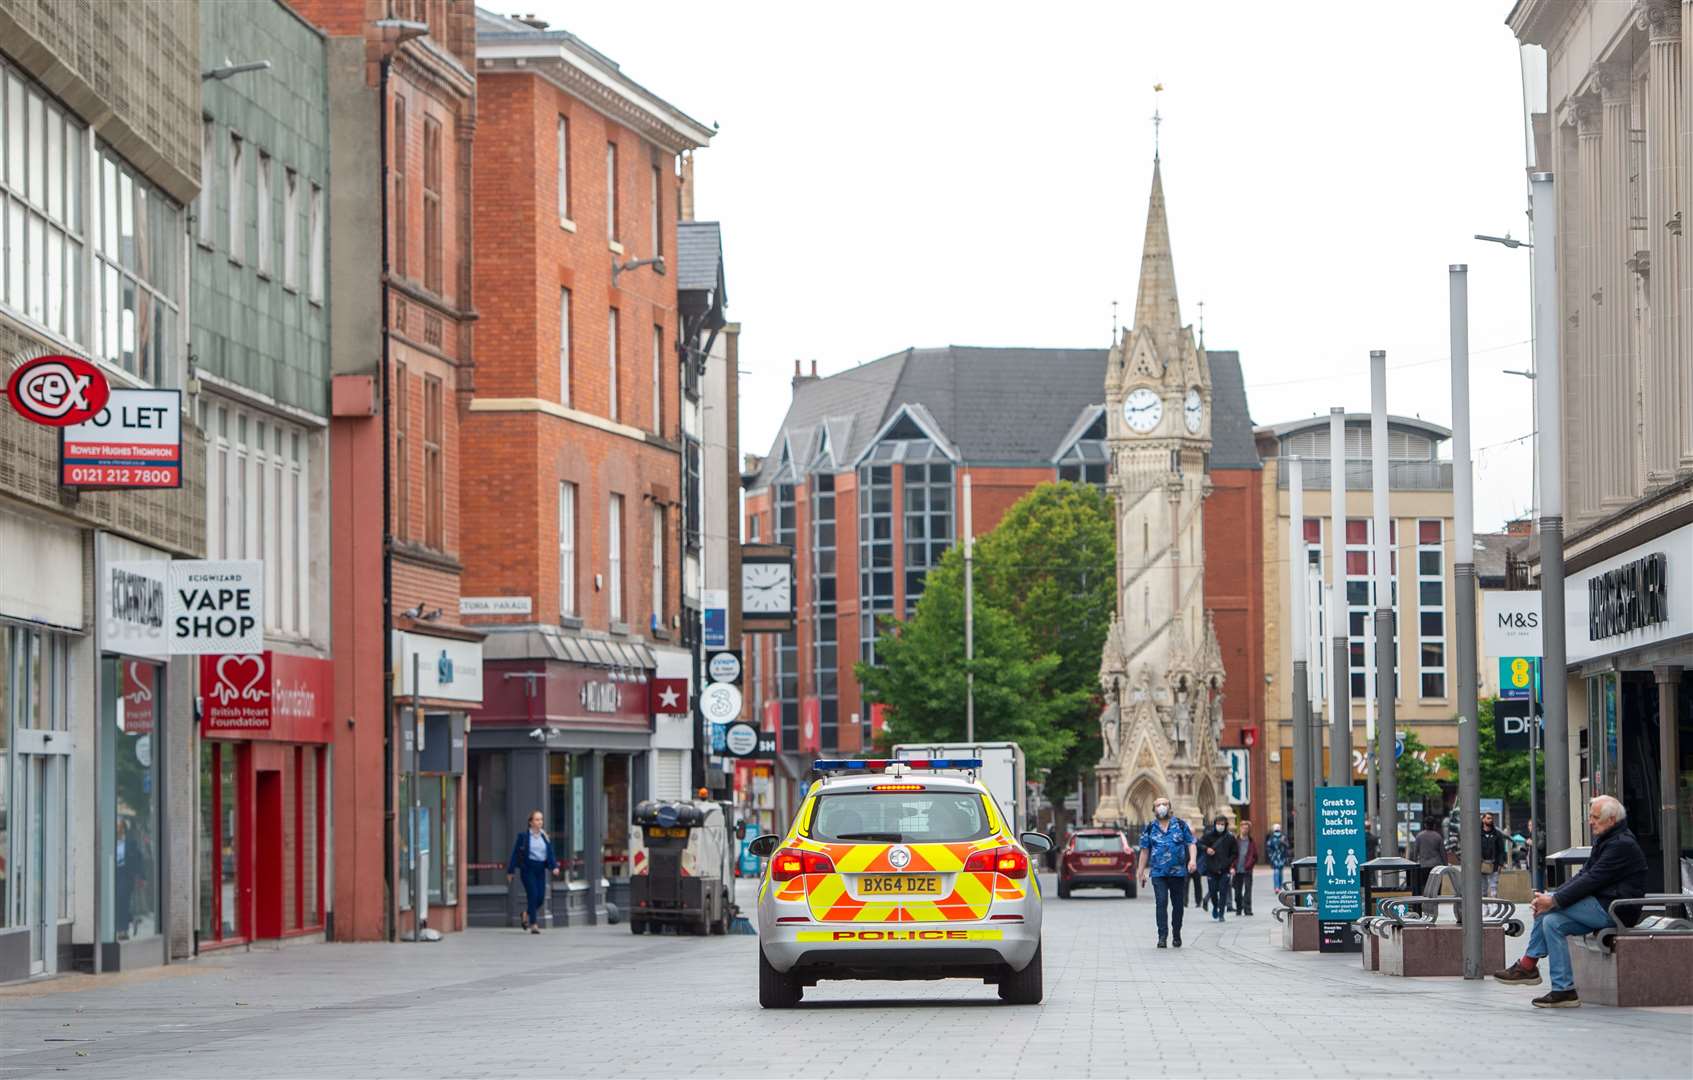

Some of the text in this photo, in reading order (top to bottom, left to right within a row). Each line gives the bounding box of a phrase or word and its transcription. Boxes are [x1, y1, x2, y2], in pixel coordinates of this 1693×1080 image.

[80, 406, 168, 428] O LET
[72, 469, 171, 483] 0121 212 7800
[178, 589, 251, 611] VAPE
[176, 616, 256, 638] SHOP
[1498, 612, 1538, 628] M&S
[710, 689, 733, 717] 3
[211, 707, 269, 717] British Heart
[210, 717, 269, 727] Foundation
[1322, 799, 1344, 807] Great
[1321, 808, 1357, 818] have you
[1322, 827, 1358, 835] Leicester
[864, 878, 937, 892] BX64 DZE
[832, 930, 968, 941] POLICE
